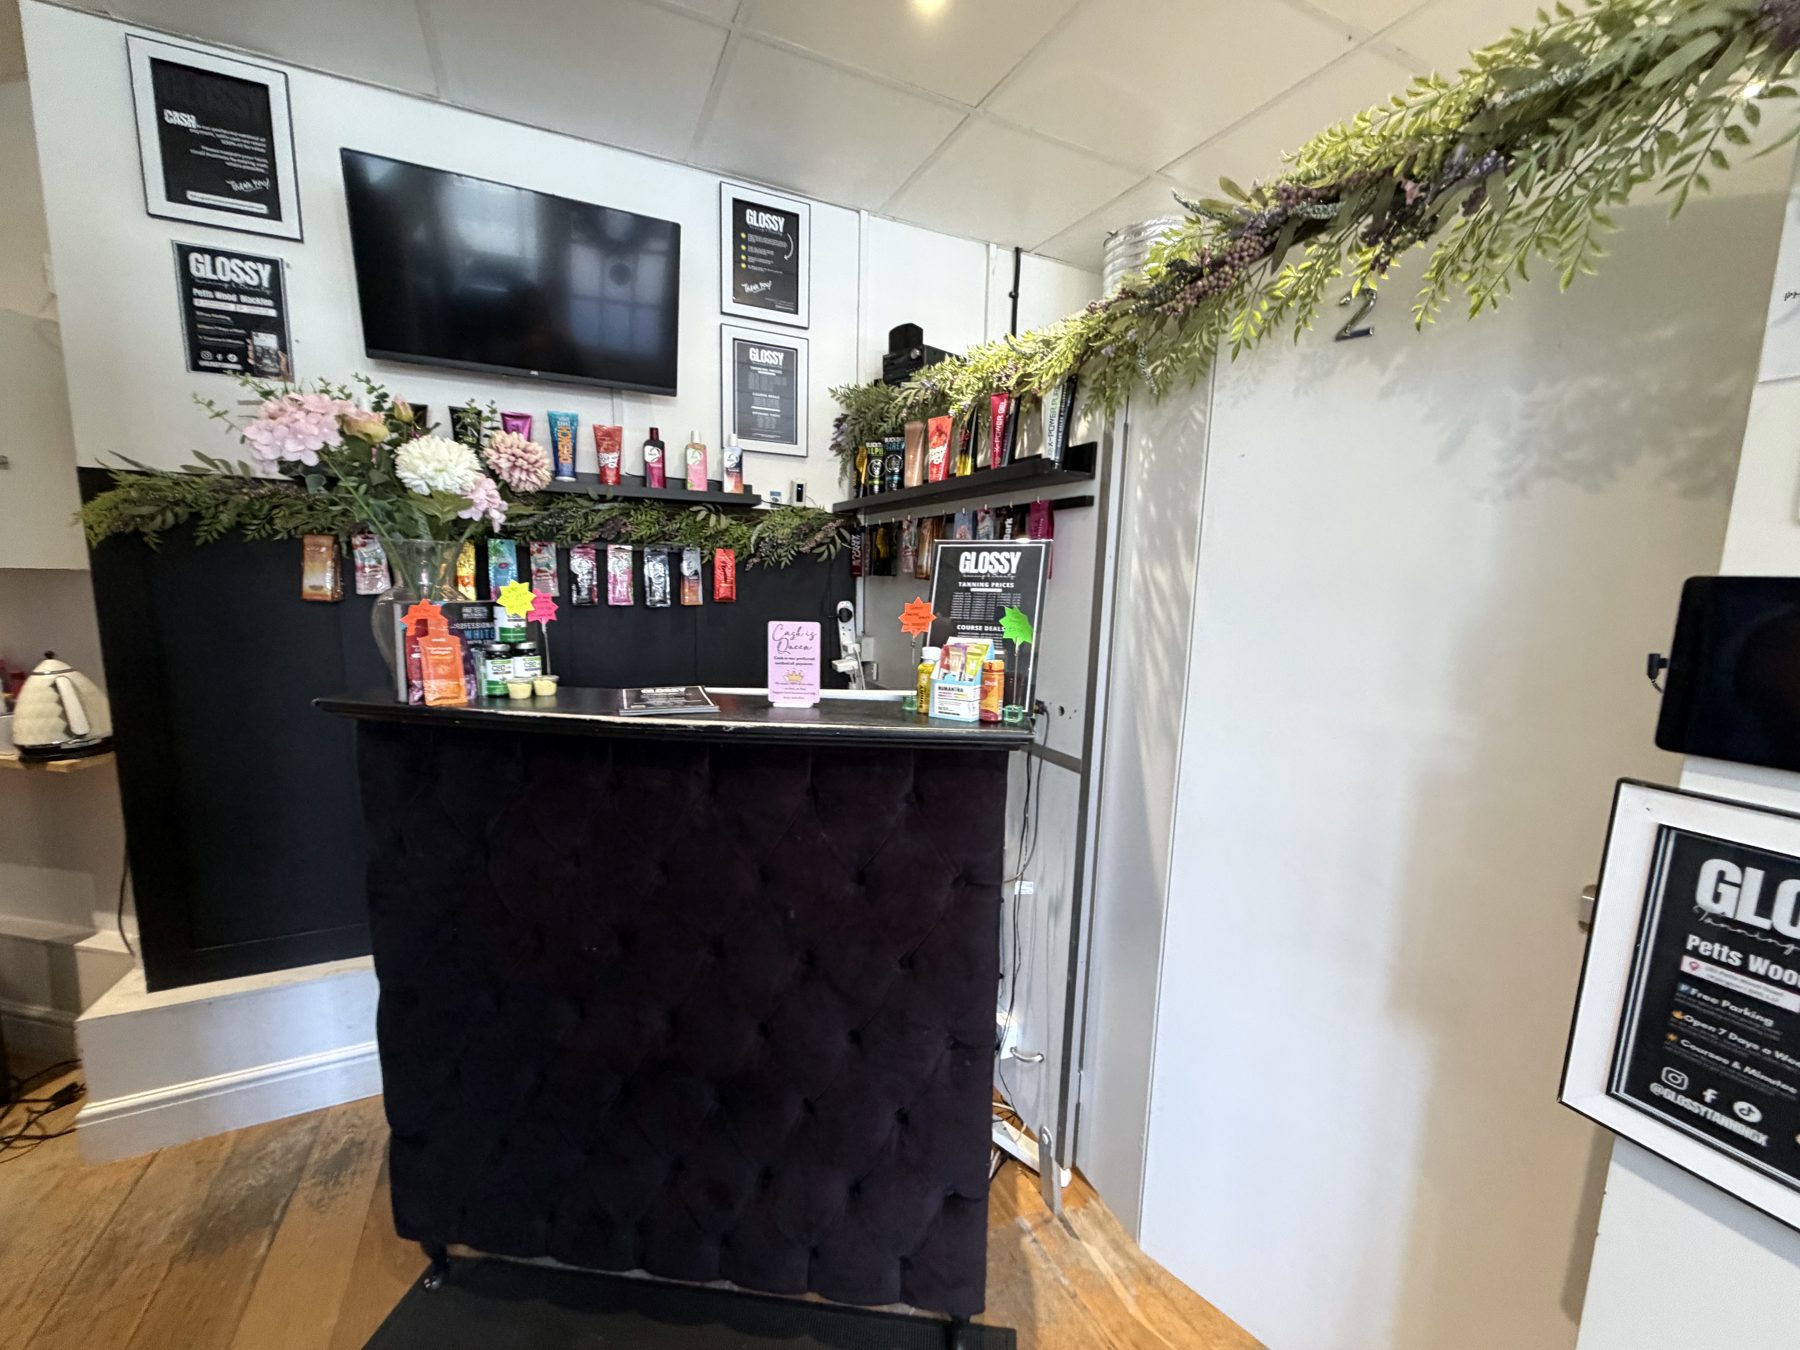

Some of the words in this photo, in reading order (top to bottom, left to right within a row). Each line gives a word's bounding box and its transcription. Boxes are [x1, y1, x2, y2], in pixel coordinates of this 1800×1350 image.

[745, 208, 785, 233] GLOSSY
[188, 252, 271, 288] GLOSSY
[749, 347, 784, 366] GLOSSY
[959, 551, 1022, 574] GLOSSY
[1685, 934, 1744, 966] Petts
[1748, 954, 1800, 988] Woo
[1690, 987, 1719, 1005] Free
[1720, 1000, 1774, 1027] Parking
[1683, 1014, 1717, 1032] Open
[1717, 1028, 1727, 1036] 7
[1728, 1032, 1760, 1050] Days
[1680, 1039, 1730, 1065] Courses
[1731, 1061, 1742, 1070] &
[1743, 1065, 1798, 1095] Minutes
